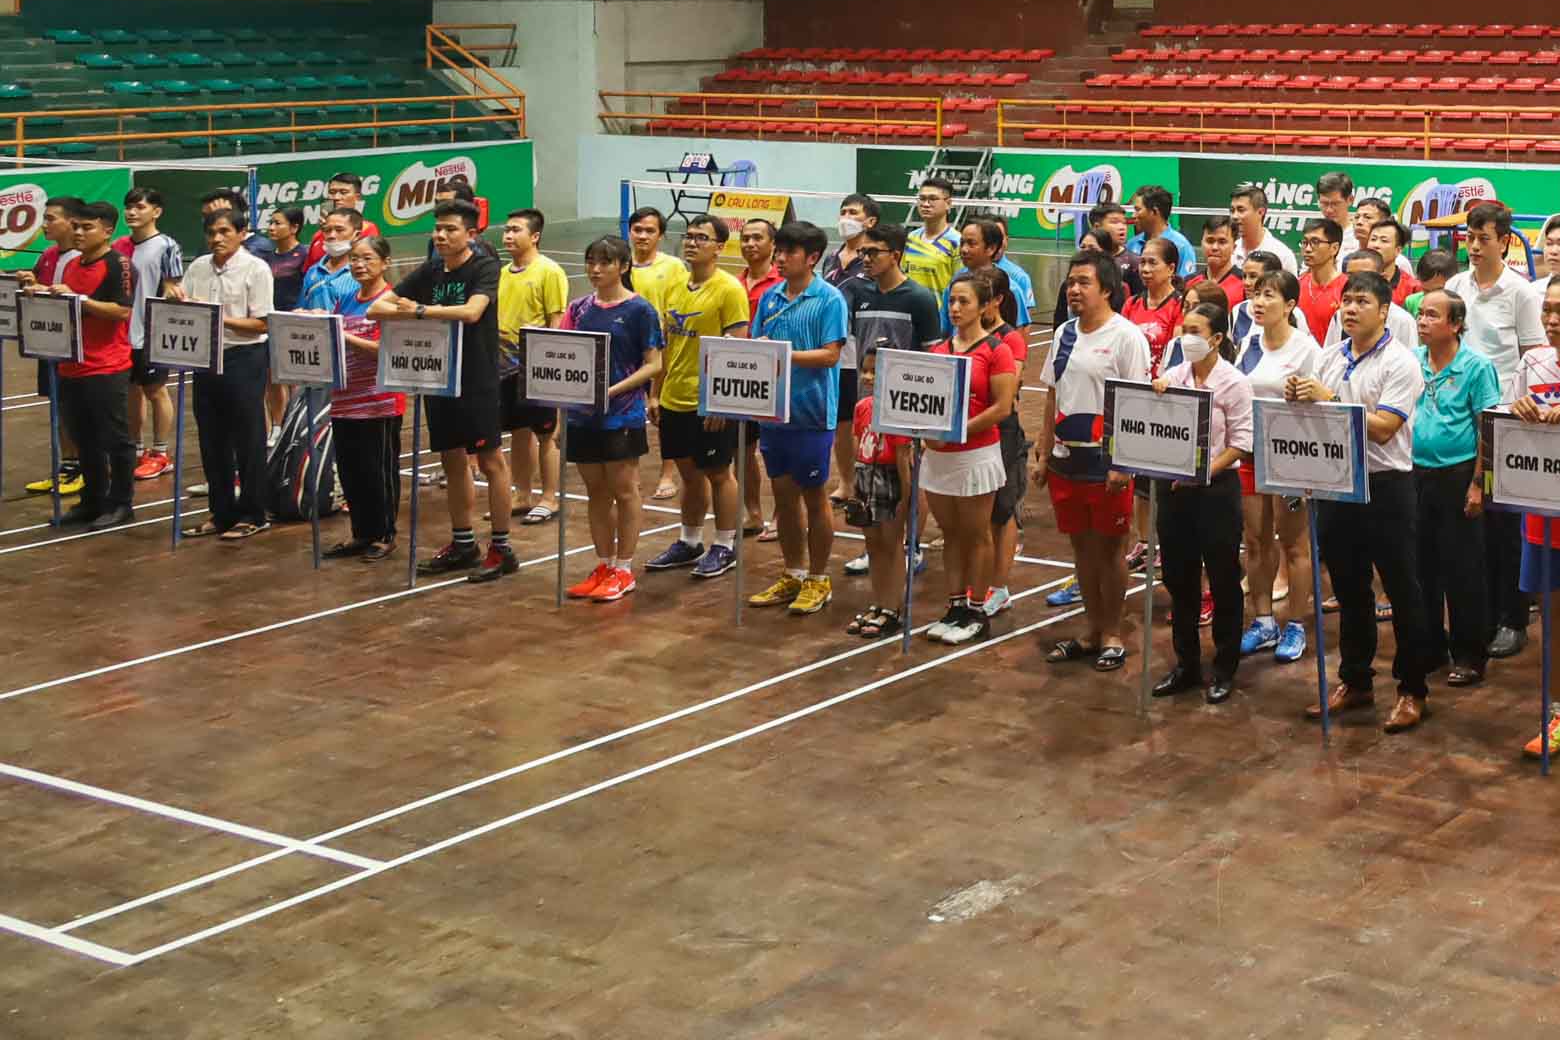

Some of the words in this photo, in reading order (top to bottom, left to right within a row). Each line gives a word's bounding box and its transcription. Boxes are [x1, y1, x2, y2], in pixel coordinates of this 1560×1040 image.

[162, 333, 178, 350] LY
[182, 334, 199, 352] LY
[713, 377, 769, 400] FUTURE
[889, 390, 945, 417] YERSIN
[1120, 419, 1145, 435] NHA
[1150, 422, 1190, 442] TRANG
[1271, 438, 1319, 460] TRỌNG
[1322, 442, 1344, 460] TÀI
[1506, 454, 1539, 473] CAM
